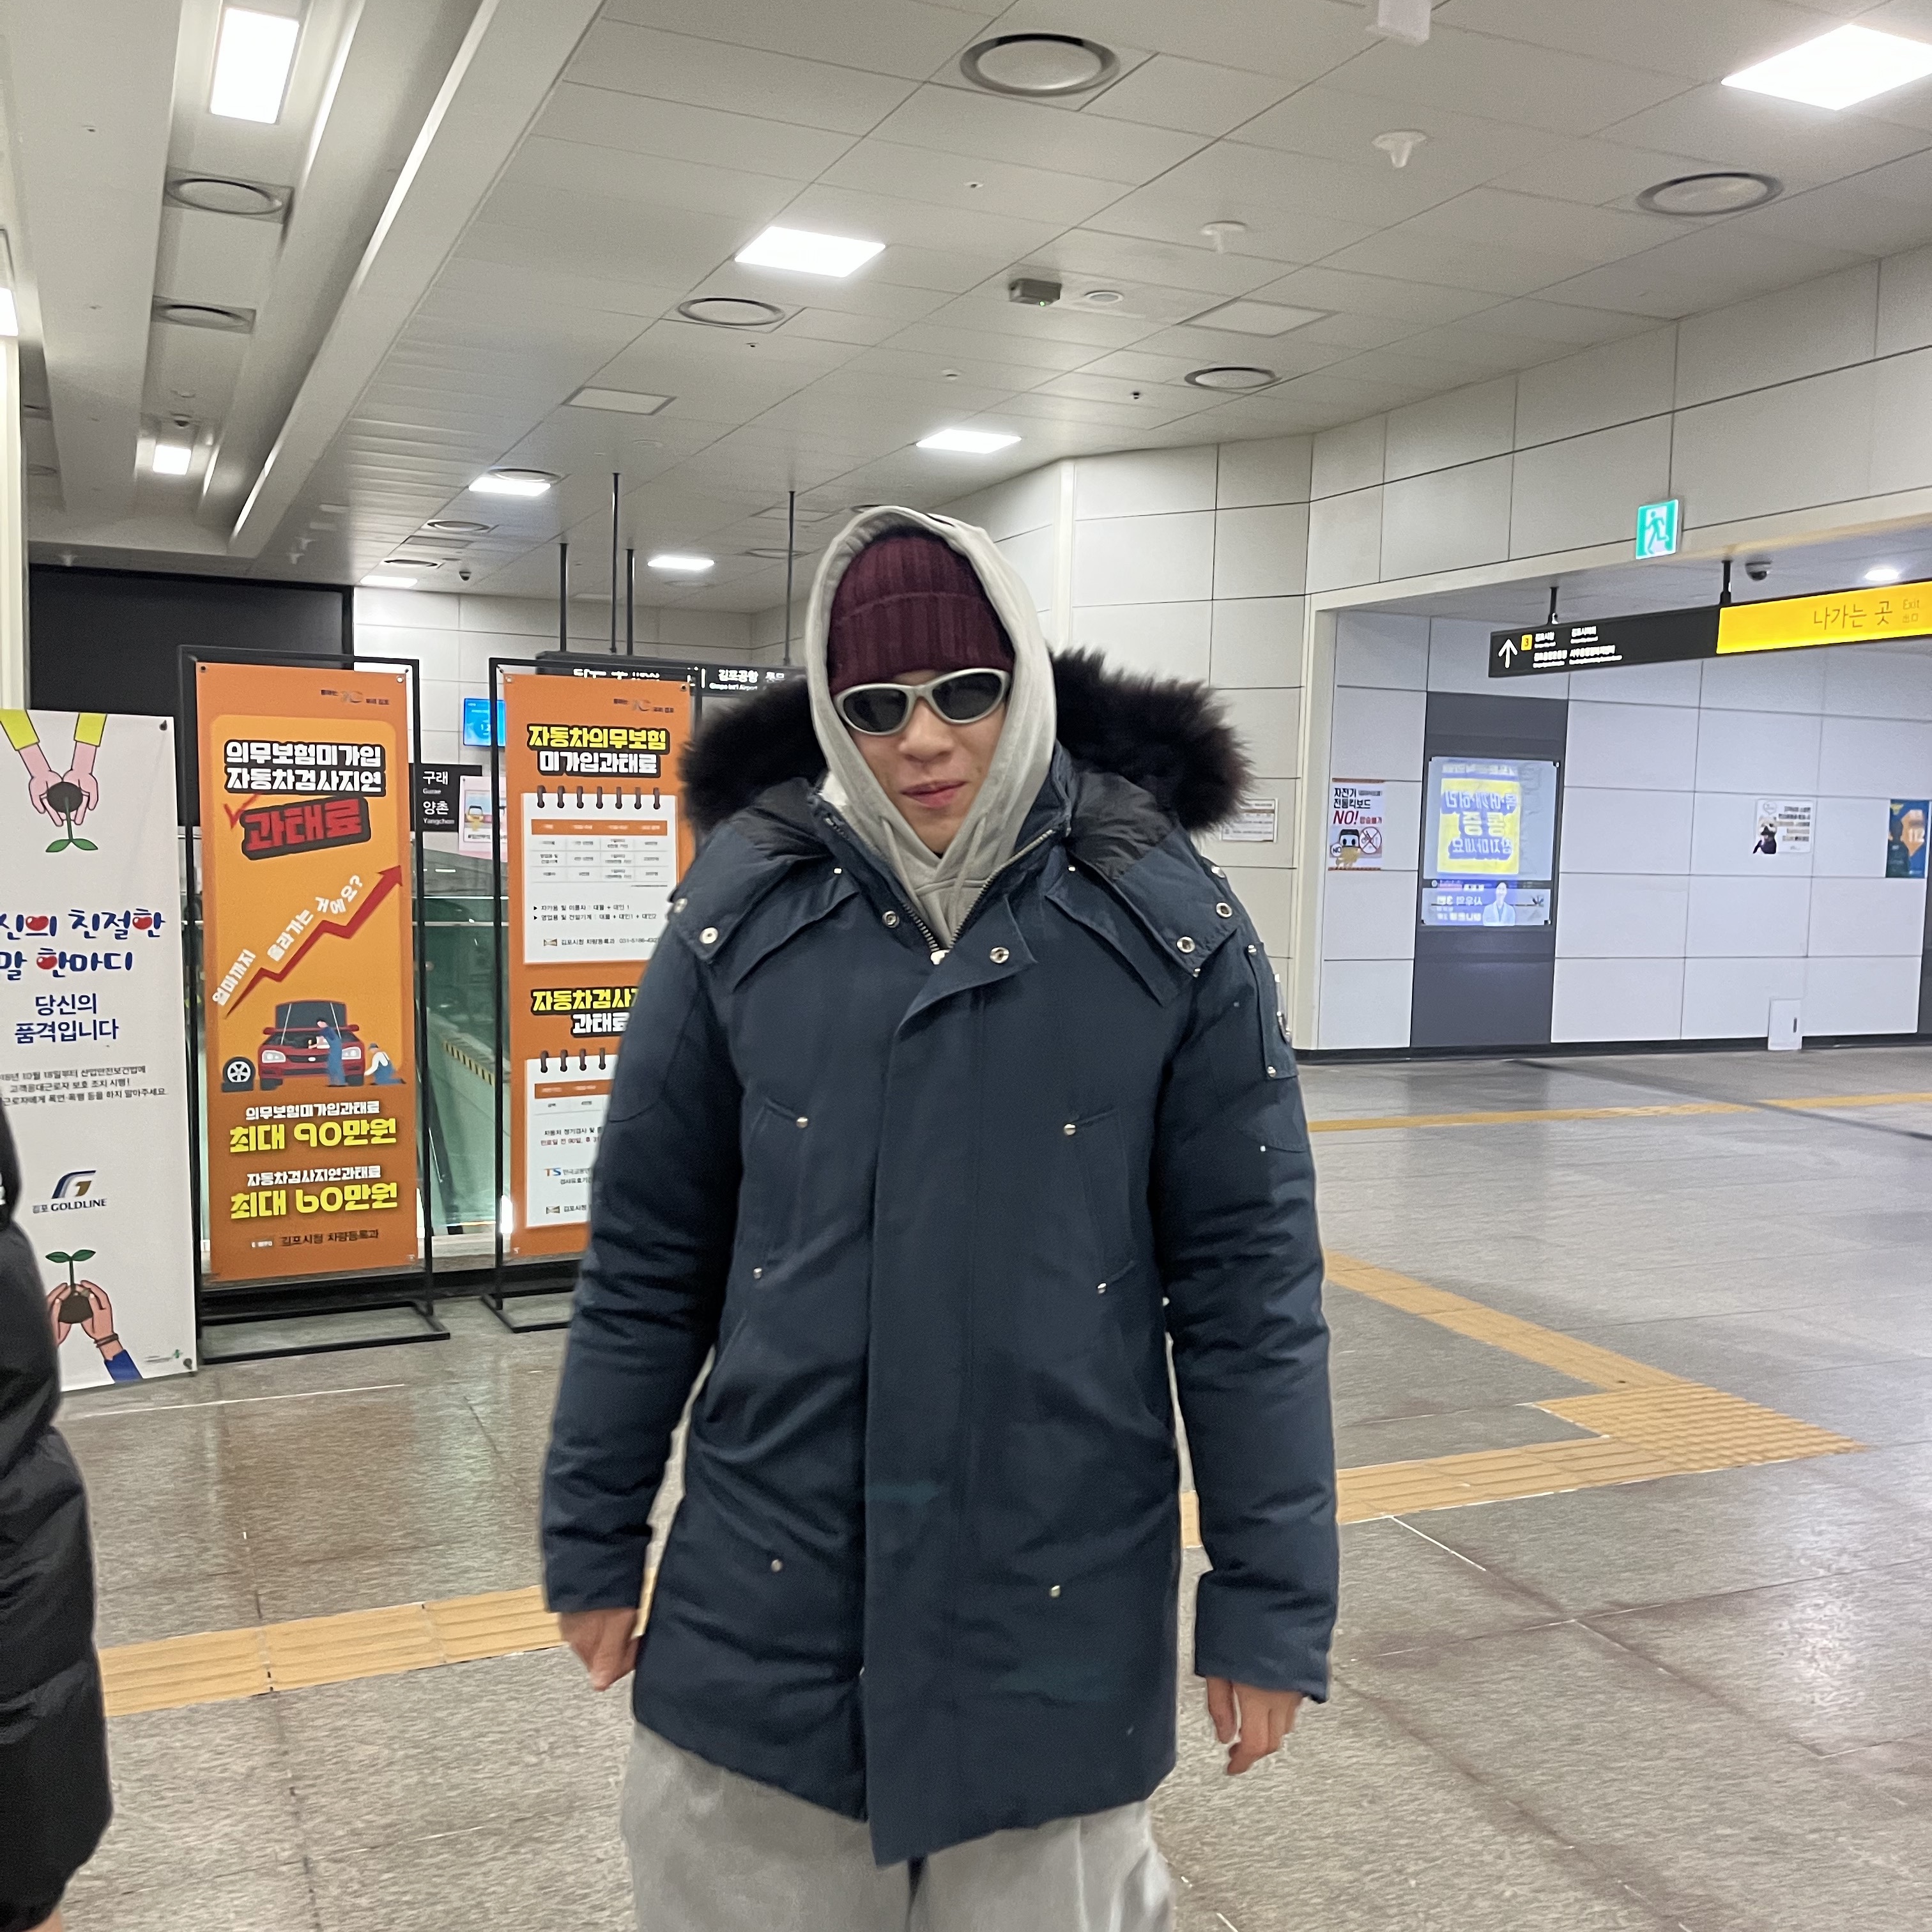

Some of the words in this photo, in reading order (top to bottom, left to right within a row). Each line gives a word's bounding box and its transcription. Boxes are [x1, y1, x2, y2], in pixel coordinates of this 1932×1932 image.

[1814, 604, 1867, 630] 나가는
[1874, 601, 1892, 625] 곳
[1903, 599, 1920, 610] Exit
[1524, 638, 1529, 647] 3
[718, 669, 758, 683] 김포공항
[528, 726, 666, 750] 자동차의무보험
[226, 742, 381, 767] 의무보험미가입
[539, 751, 657, 774] 미가입과태료
[226, 767, 381, 792] 자동차검사지연
[422, 771, 448, 785] 구래
[422, 801, 449, 815] 양촌
[1333, 811, 1359, 825] NO!
[245, 799, 362, 852] 과태료
[68, 908, 166, 940] 친절한
[267, 909, 314, 962] 올라가는
[36, 947, 133, 977] 한마디
[212, 949, 256, 1006] 얼마까지
[35, 993, 96, 1016] 당신의
[15, 1018, 119, 1044] 품격입니다
[573, 1012, 631, 1034] 과태료
[106, 1089, 122, 1098] 하지
[245, 1101, 380, 1121] 의무보험미가입과태료
[229, 1124, 286, 1153] 최대
[293, 1118, 397, 1147] 90만원
[247, 1165, 381, 1186] 자동차검사지연과태료
[544, 1167, 562, 1176] TS
[50, 1199, 107, 1212] GOLDLINE
[231, 1190, 286, 1219] 최대
[295, 1182, 397, 1213] 60만원
